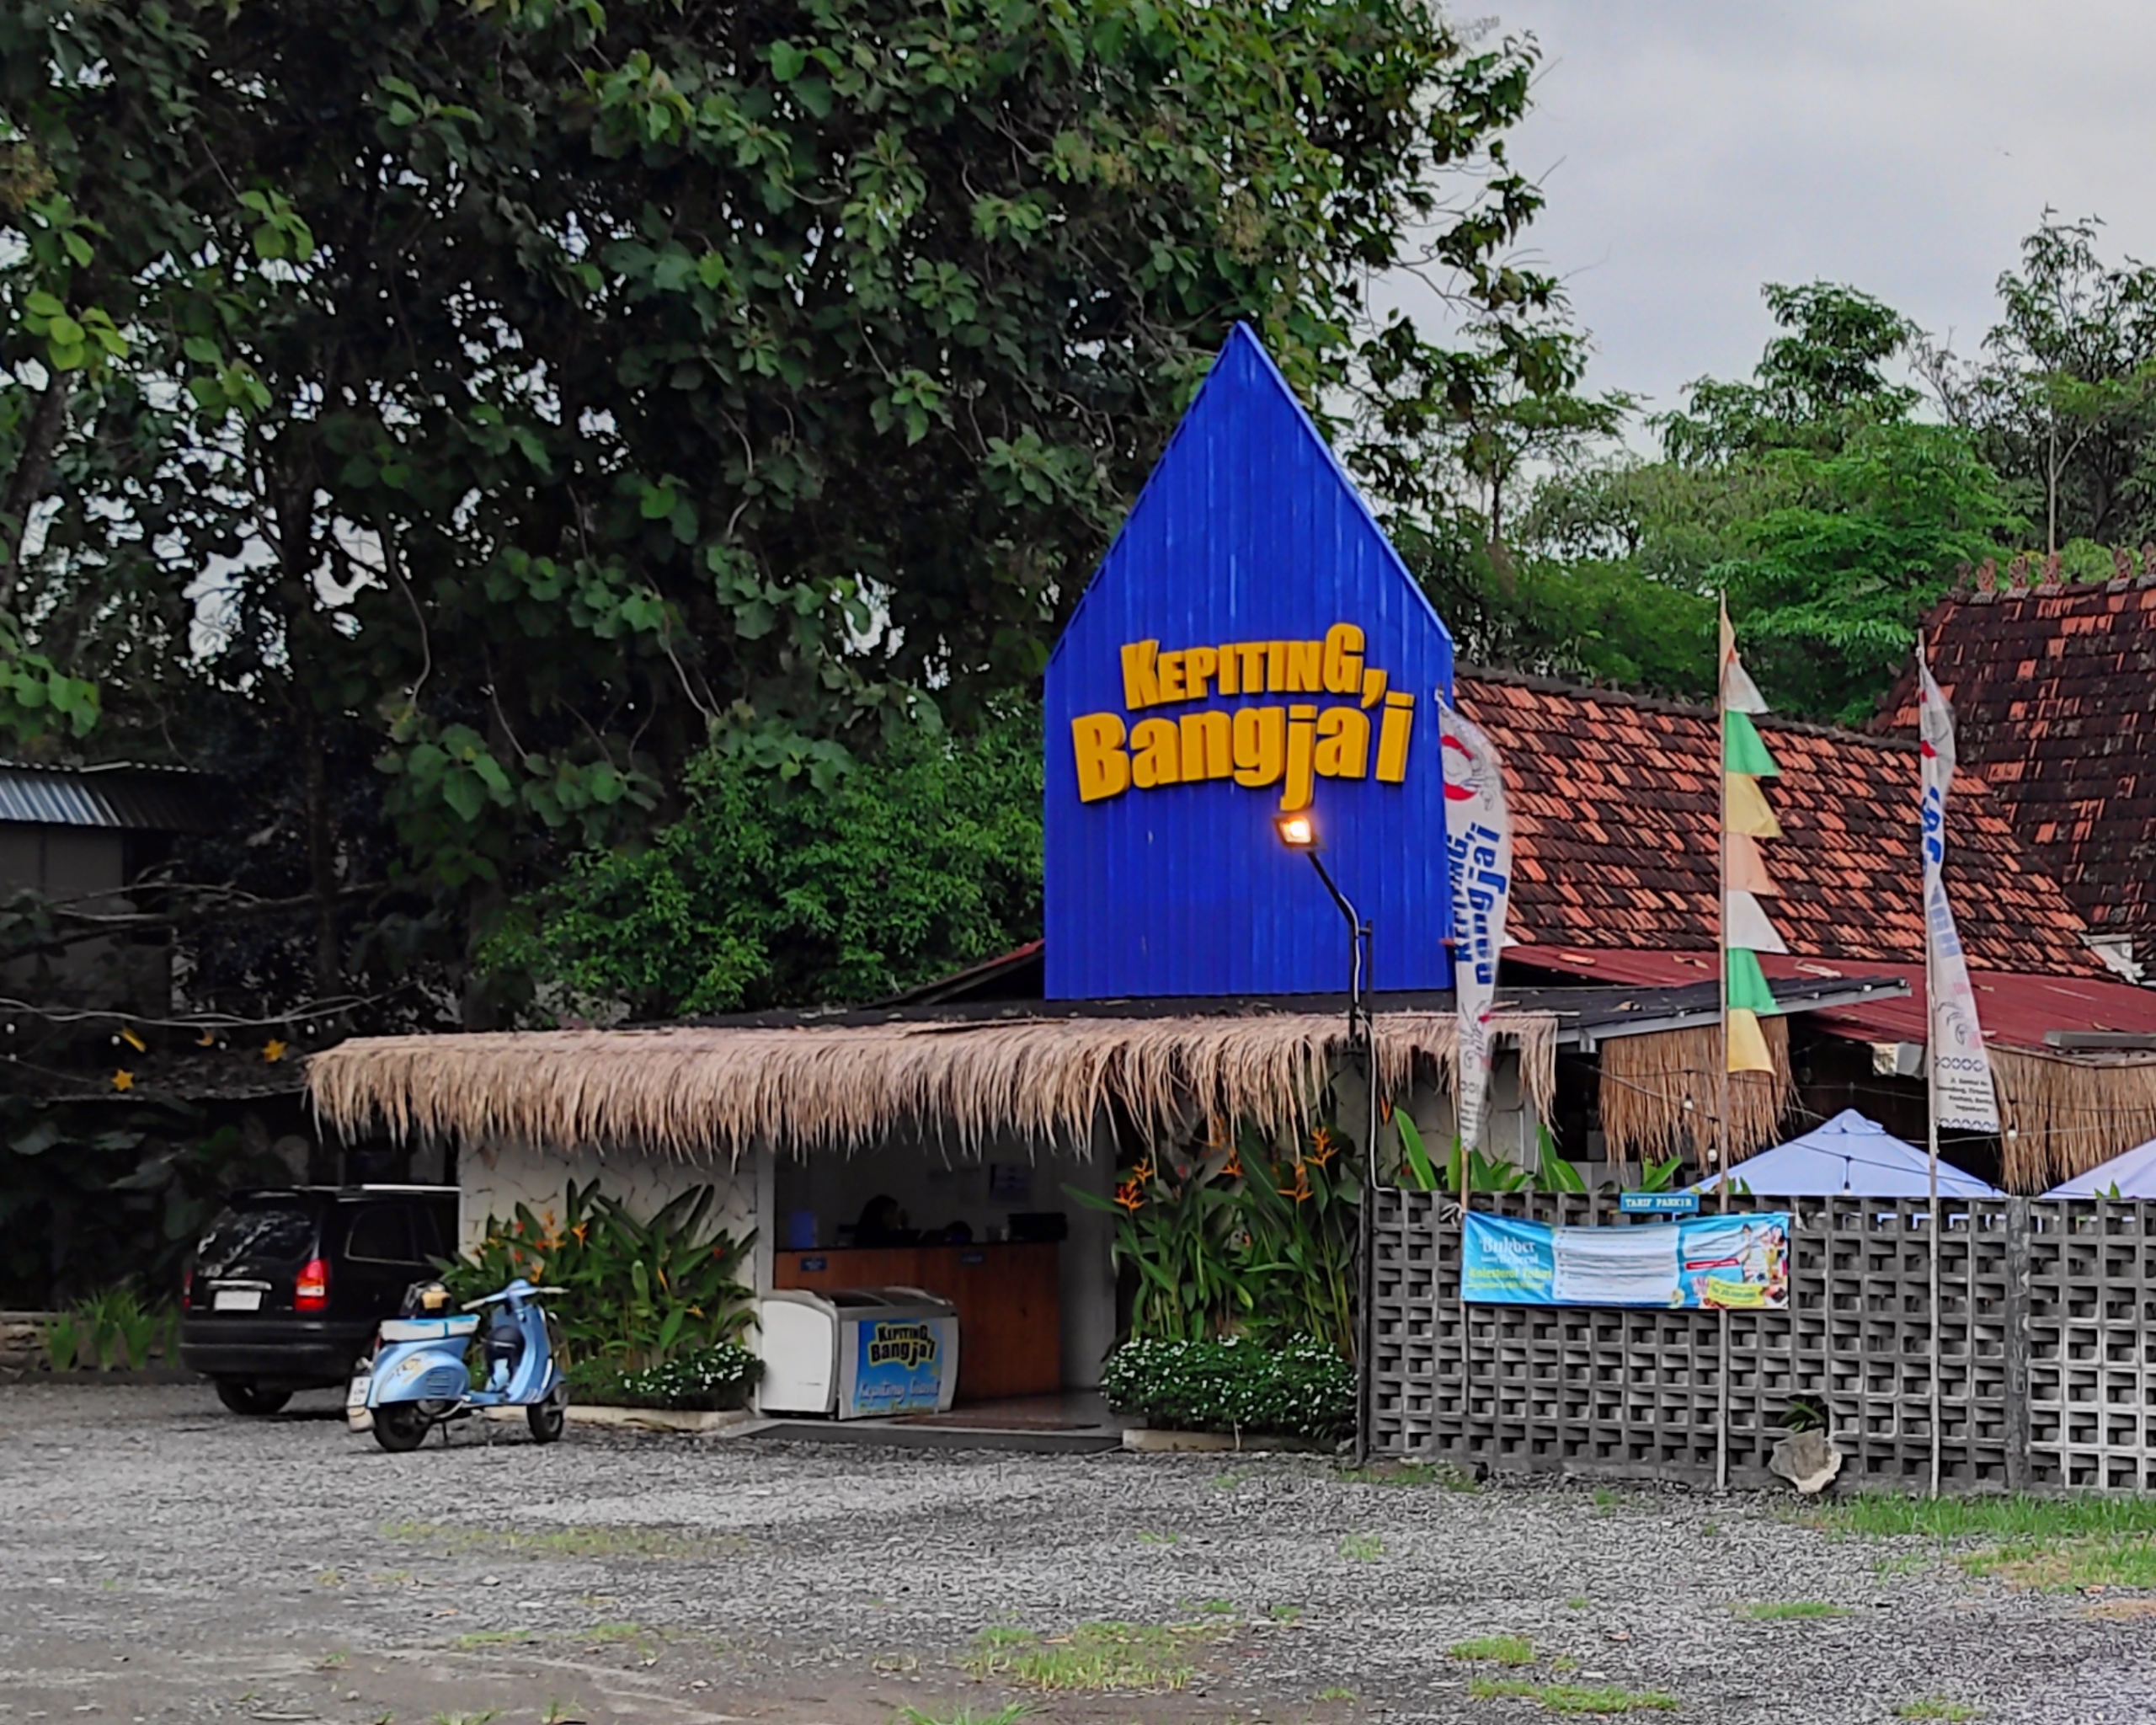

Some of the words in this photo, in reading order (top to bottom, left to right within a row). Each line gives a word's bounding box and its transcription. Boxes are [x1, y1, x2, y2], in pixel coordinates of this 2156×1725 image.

[1121, 622, 1365, 710] KEPITING
[1071, 669, 1415, 811] Bangja'i
[1656, 1197, 1693, 1208] PARKIR
